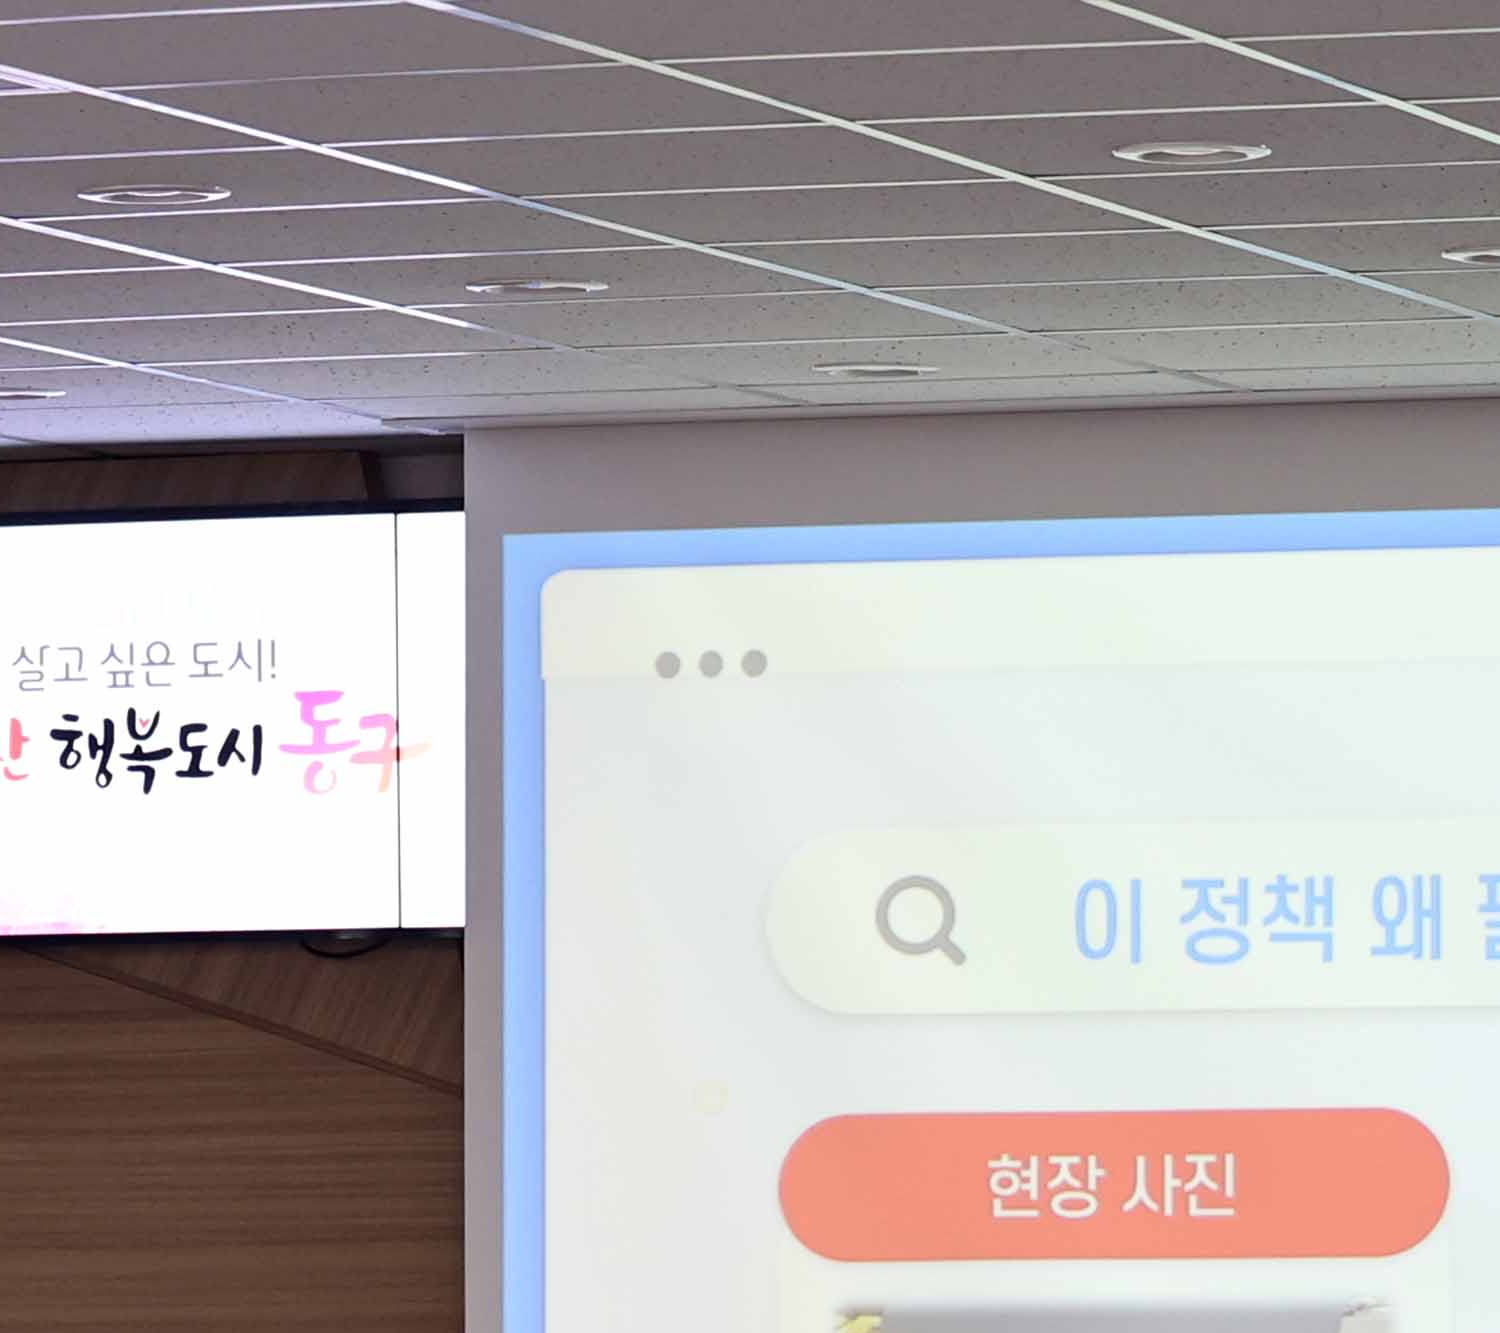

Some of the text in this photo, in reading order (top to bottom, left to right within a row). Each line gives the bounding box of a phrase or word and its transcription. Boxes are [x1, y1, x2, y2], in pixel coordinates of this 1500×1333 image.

[12, 638, 277, 692] 살고 싶은 도시!
[49, 707, 263, 795] 행복도시
[277, 688, 431, 796] 동구
[1074, 878, 1143, 966] 이
[1179, 873, 1335, 967] 정책
[1370, 873, 1443, 961] 왜
[987, 1152, 1237, 1220] 현장 사진
